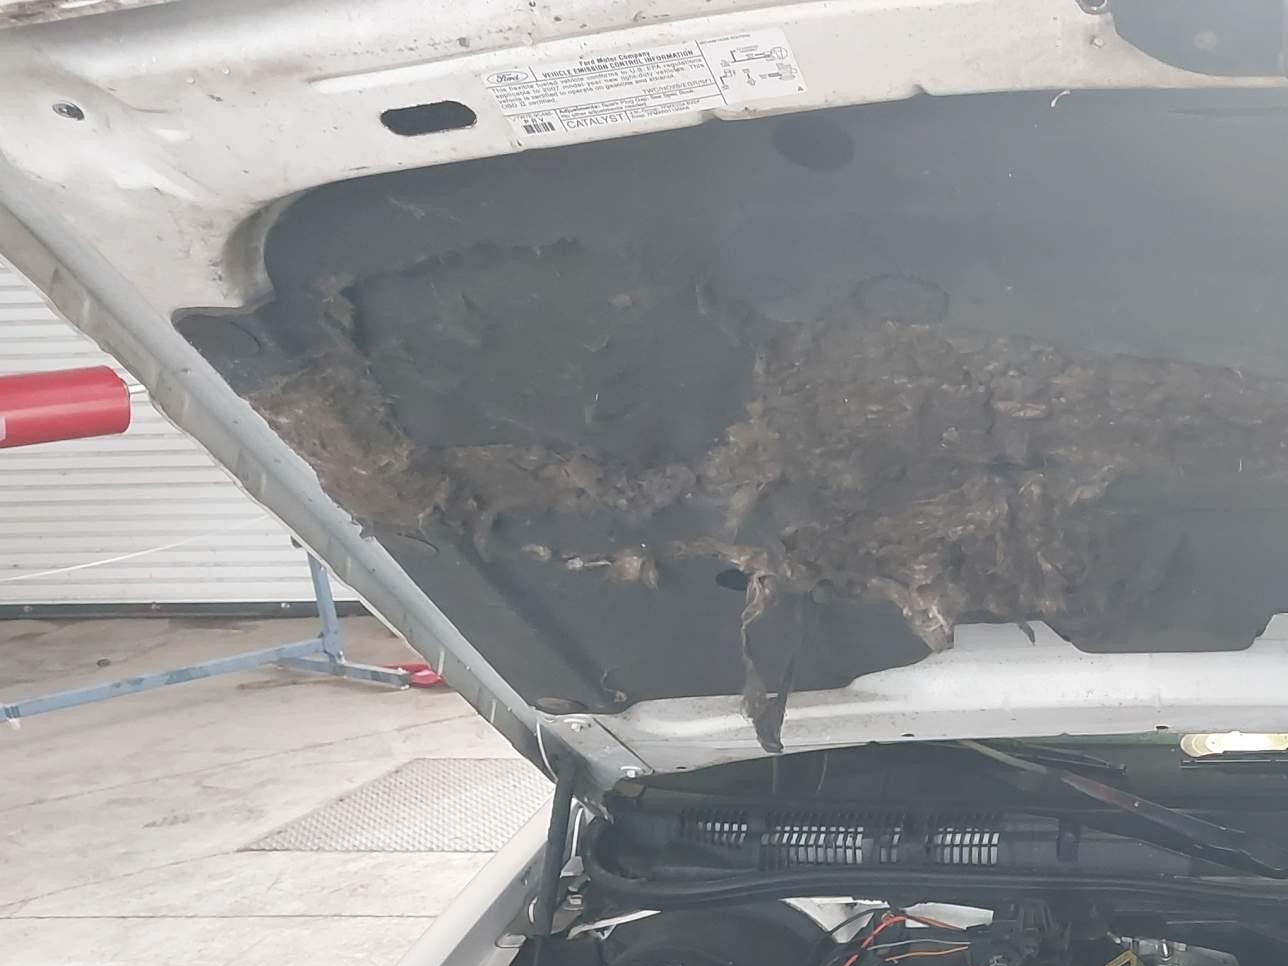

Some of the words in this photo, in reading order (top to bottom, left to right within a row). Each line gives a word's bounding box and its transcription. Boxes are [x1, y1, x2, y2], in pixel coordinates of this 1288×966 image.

[542, 68, 571, 79] VEHICLE
[573, 63, 608, 74] EMISSION
[610, 58, 642, 68] CONTROL
[644, 50, 694, 62] INFORMATION
[578, 58, 596, 66] Ford
[596, 56, 616, 65] Motor
[618, 52, 650, 62] Company
[496, 73, 519, 83] Ford
[566, 113, 624, 128] CATALYST
